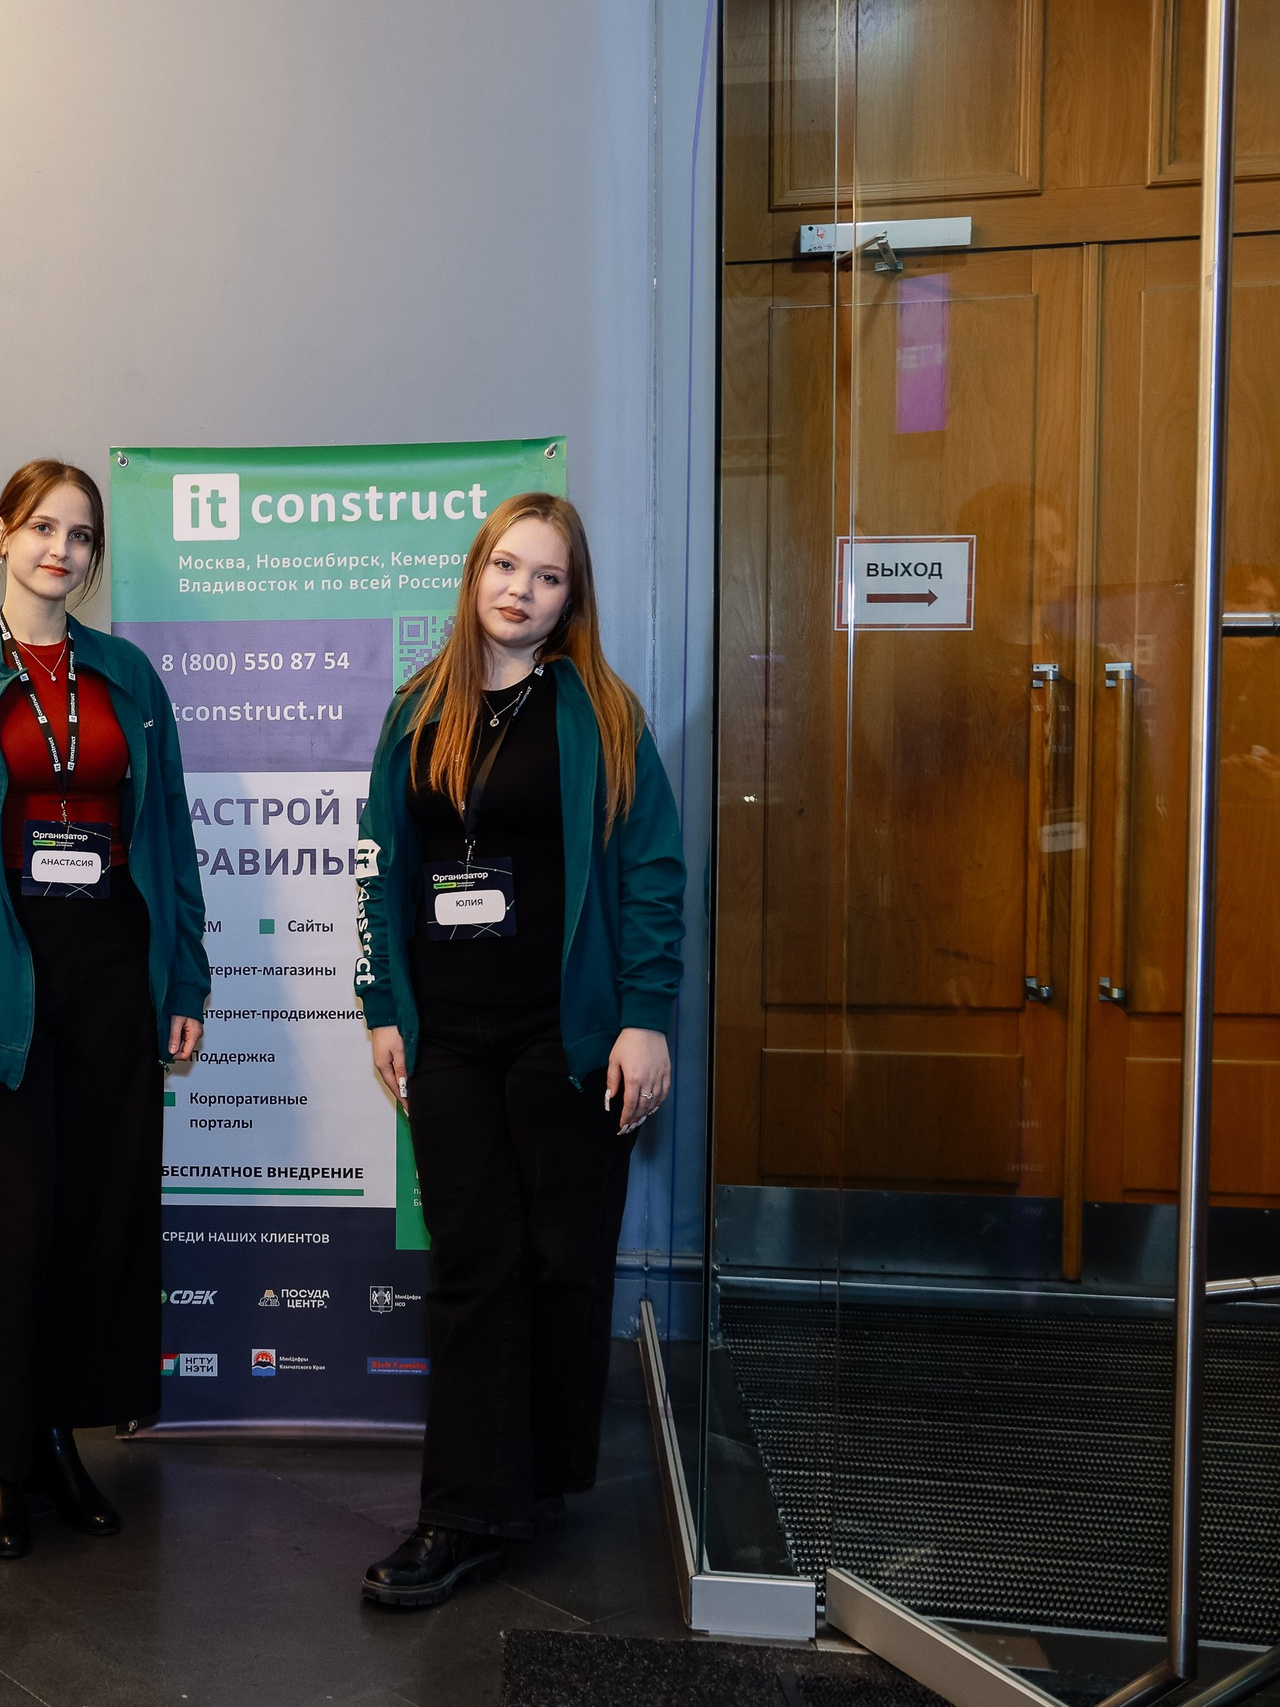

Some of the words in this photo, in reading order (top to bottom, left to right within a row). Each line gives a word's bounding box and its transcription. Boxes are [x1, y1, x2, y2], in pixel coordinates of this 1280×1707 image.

[251, 483, 488, 524] construct
[178, 555, 250, 571] Москва,
[257, 552, 386, 571] Новосибирск,
[866, 562, 943, 580] ВЫХОД
[178, 577, 298, 595] Владивосток
[304, 578, 315, 591] и
[321, 577, 343, 591] по
[350, 574, 392, 591] всей
[162, 654, 175, 672] 8
[181, 652, 237, 676] (800)
[243, 653, 283, 671] 550
[290, 653, 315, 671] 87
[324, 652, 350, 670] 54
[171, 701, 343, 722] tconstruct.ru
[190, 789, 340, 826] АСТРОЙ
[32, 830, 88, 842] Организатор
[40, 858, 94, 867] АНАСТАСИЯ
[196, 848, 357, 876] РАВИЛЬ
[432, 872, 489, 883] Организатор
[455, 898, 483, 907] ЮЛИЯ
[287, 919, 334, 933] Сайты
[209, 965, 336, 979] тернет-магазины
[203, 1008, 364, 1023] нтернет-продвижение
[190, 1051, 275, 1065] Поддержка
[190, 1092, 308, 1108] Корпоративные
[190, 1117, 253, 1131] порталы
[161, 1166, 263, 1178] БЕСПЛАТНОЕ
[267, 1166, 364, 1181] ВНЕДРЕНИЕ
[162, 1231, 205, 1244] СРЕДИ
[208, 1232, 257, 1243] НАШИХ
[260, 1232, 330, 1244] КЛИЕНТОВ
[169, 1289, 218, 1305] CDEK
[281, 1288, 330, 1300] ПОСУДА
[185, 1357, 214, 1365] НГТУ
[185, 1365, 214, 1373] НЭТИ
